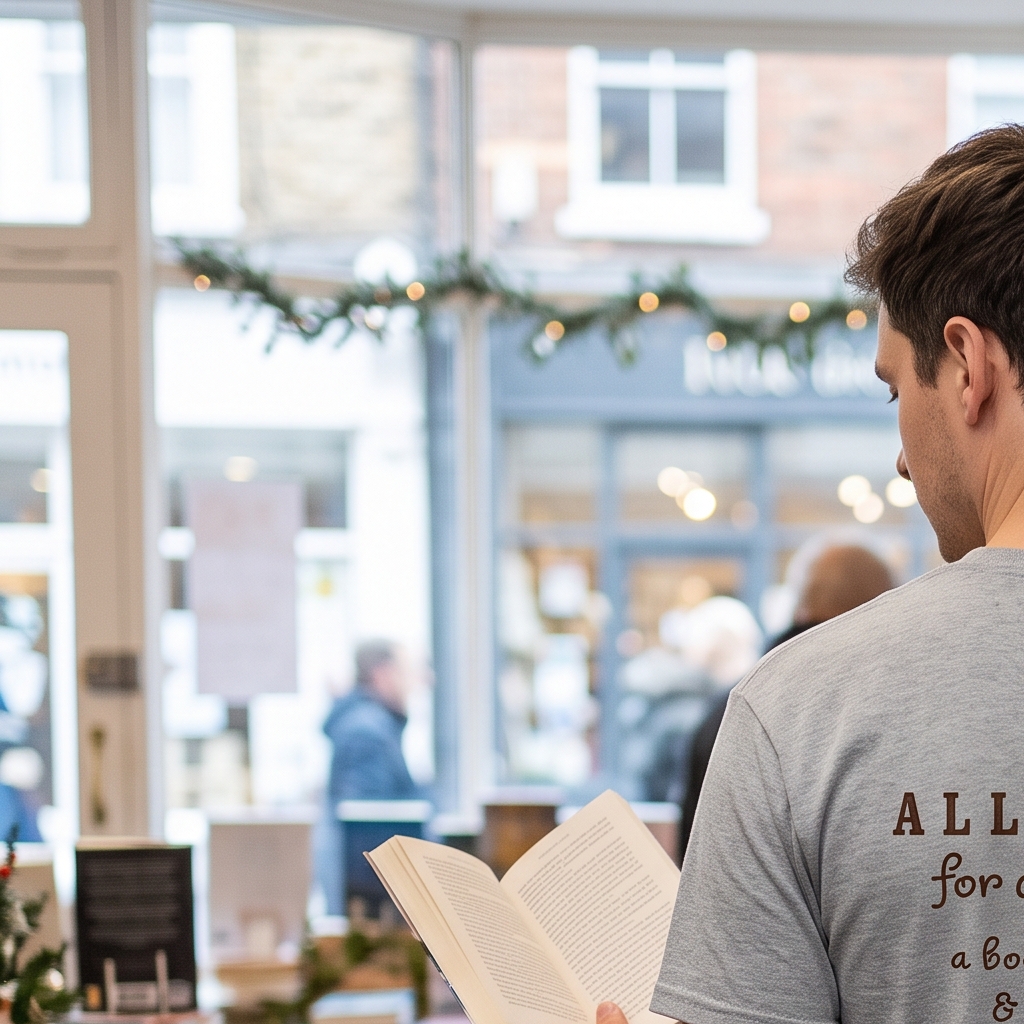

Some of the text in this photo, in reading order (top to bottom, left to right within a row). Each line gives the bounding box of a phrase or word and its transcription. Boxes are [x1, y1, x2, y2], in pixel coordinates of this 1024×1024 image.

[892, 791, 1019, 836] ALL
[930, 851, 1004, 910] for
[950, 951, 972, 970] a
[992, 991, 1019, 1023] &
